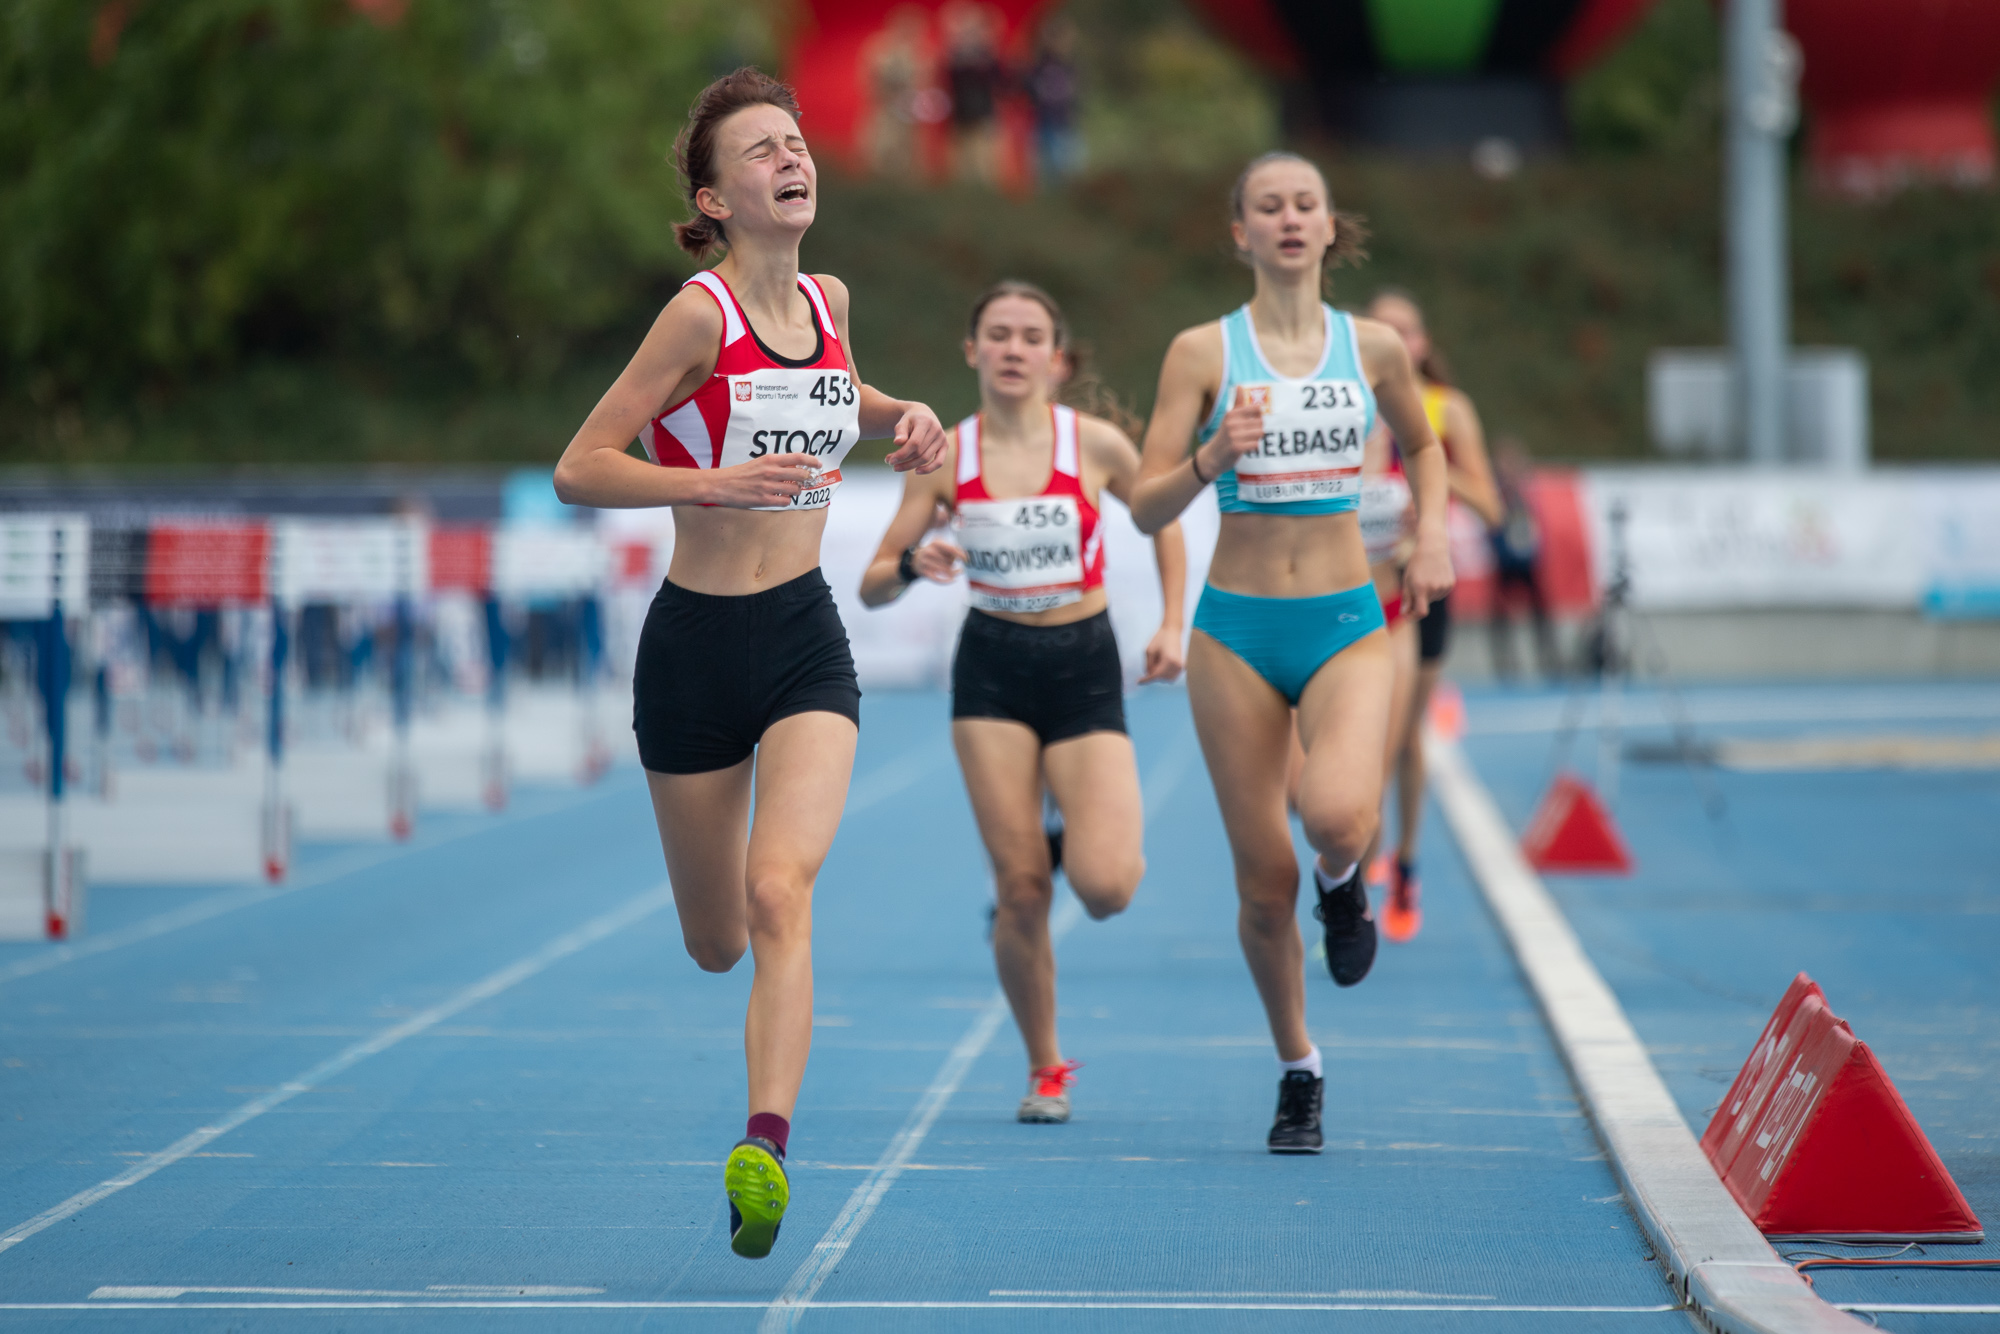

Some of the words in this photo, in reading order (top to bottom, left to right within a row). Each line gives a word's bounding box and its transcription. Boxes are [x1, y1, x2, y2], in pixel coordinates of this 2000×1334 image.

[809, 376, 855, 406] 453
[1301, 386, 1356, 411] 231
[749, 430, 843, 459] STOCH
[1243, 427, 1359, 459] EŁBASA
[803, 488, 830, 506] 2022
[1312, 481, 1344, 495] 2022
[1014, 504, 1069, 530] 456
